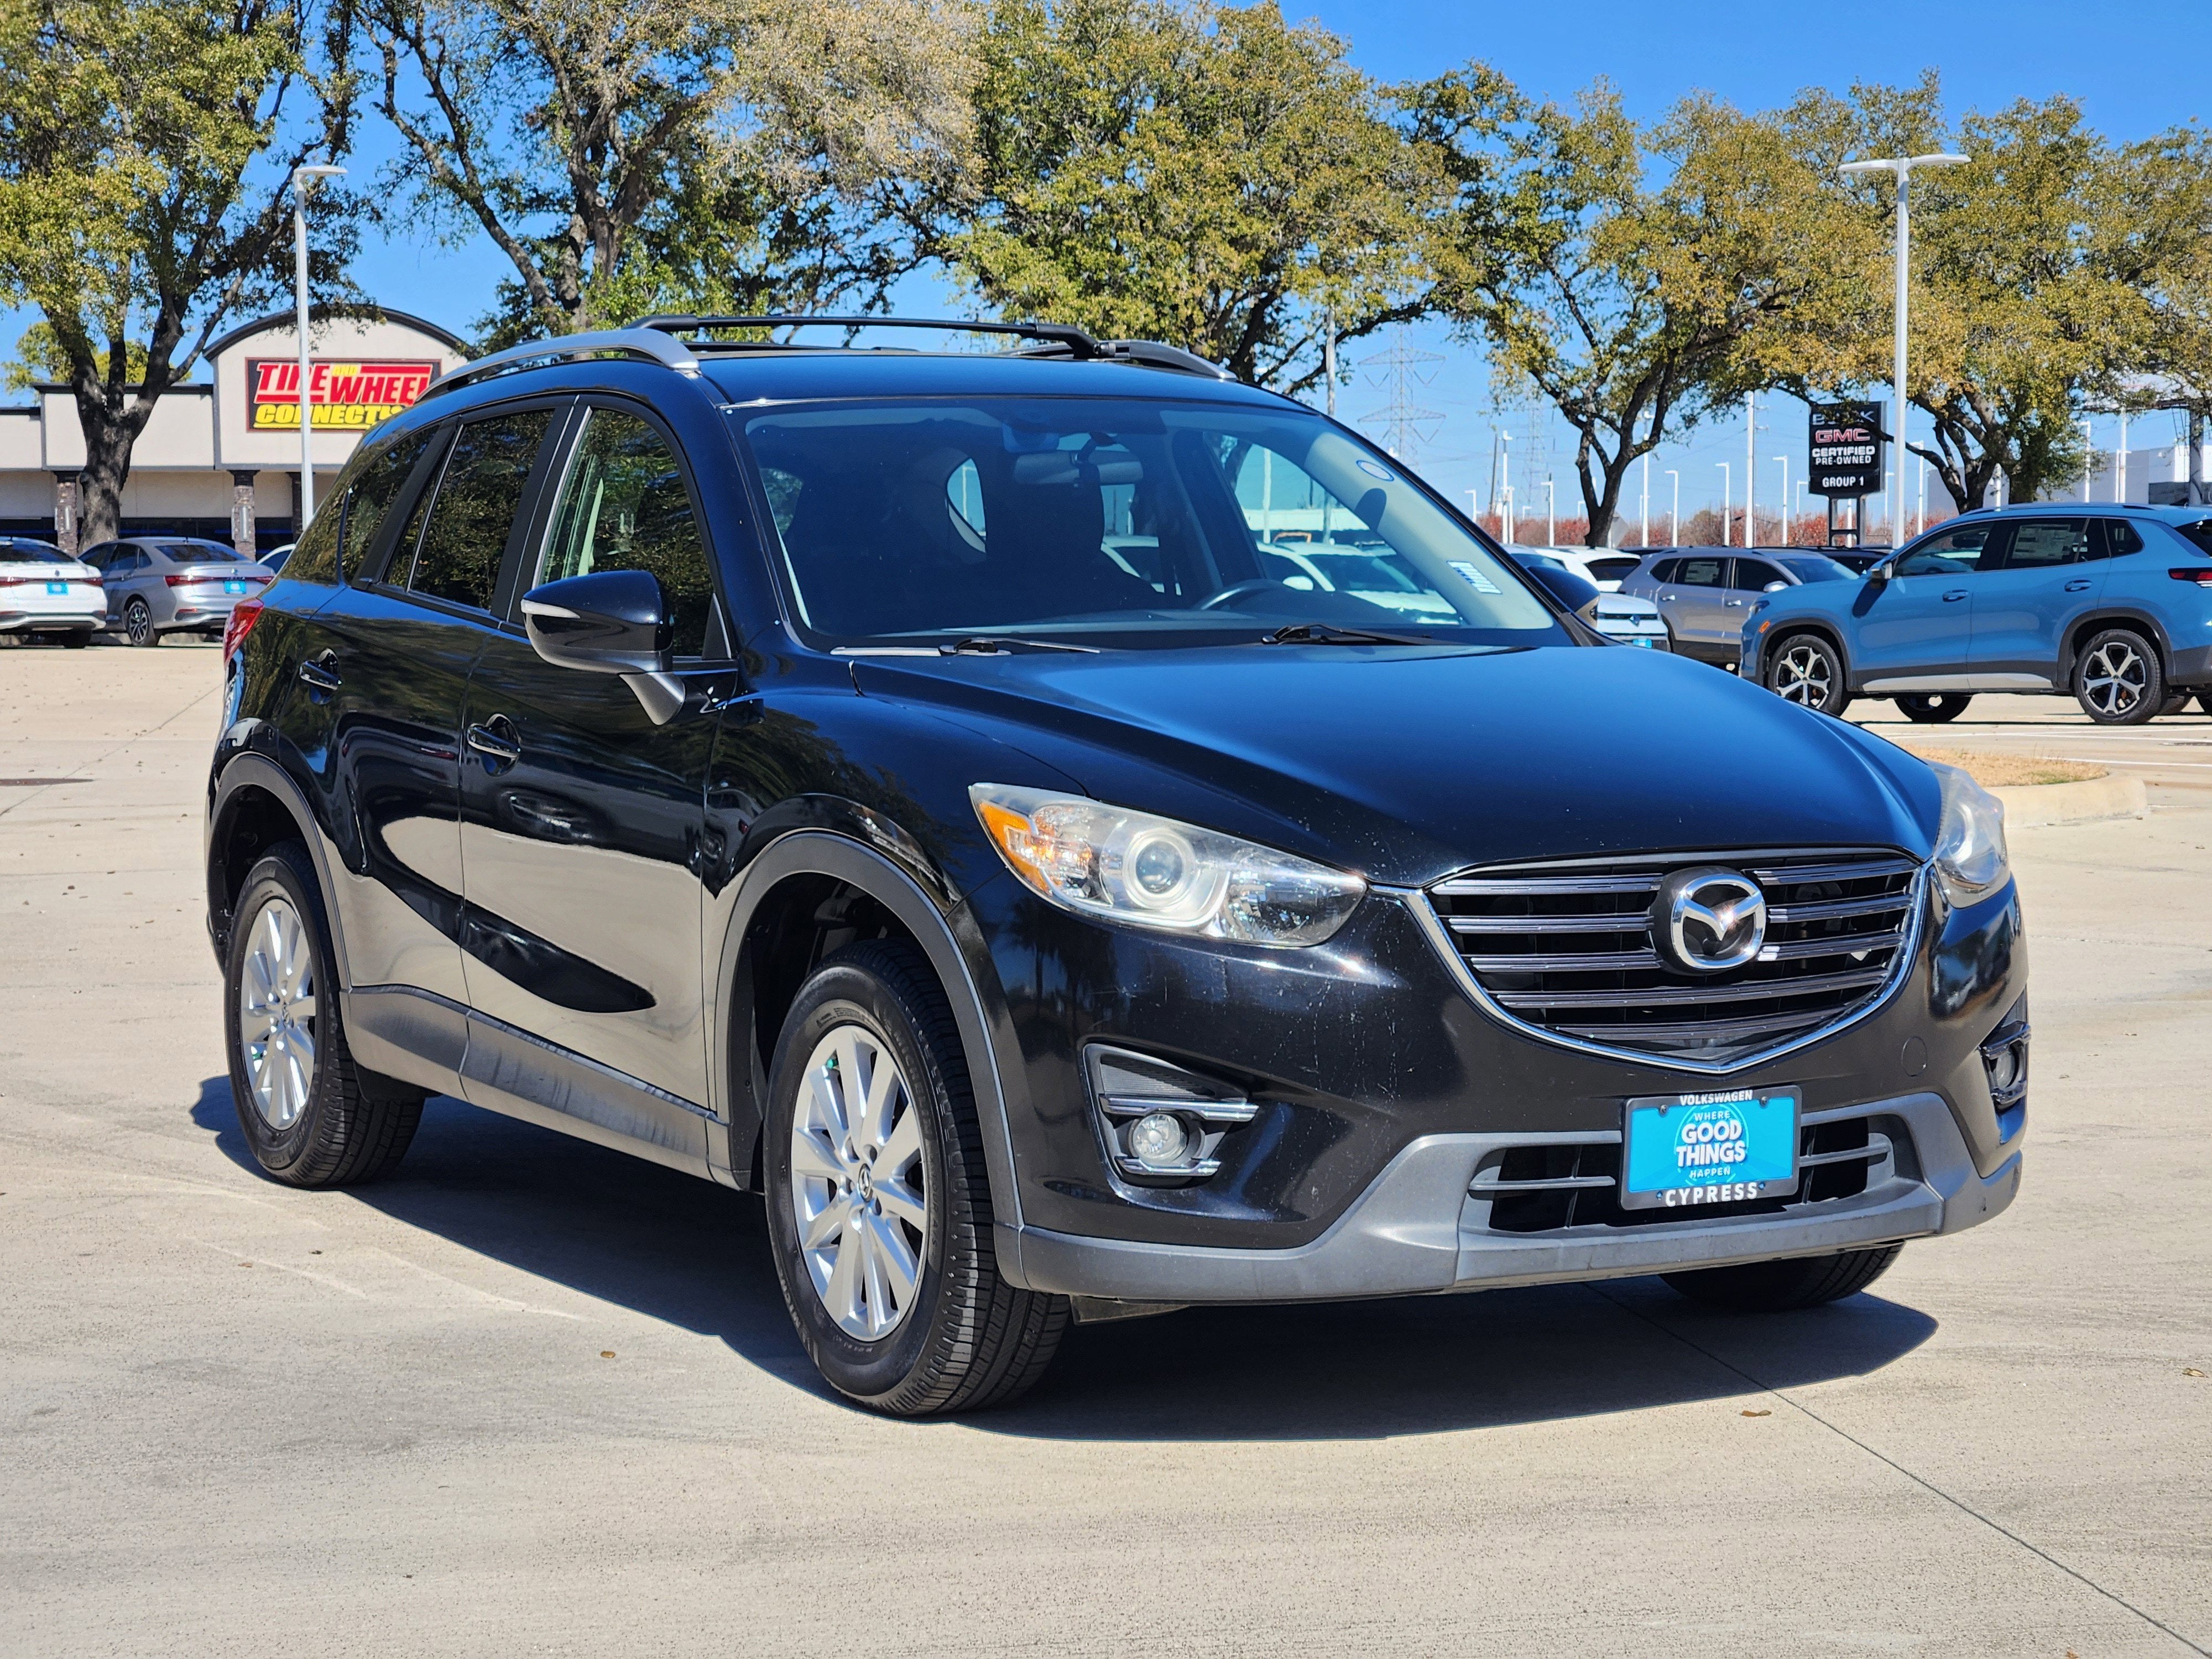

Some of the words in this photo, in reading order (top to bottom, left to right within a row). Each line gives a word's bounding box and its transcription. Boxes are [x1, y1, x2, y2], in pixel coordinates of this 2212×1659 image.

[332, 365, 358, 376] AND
[1815, 427, 1870, 443] GMC
[1812, 445, 1875, 457] CERTIFIED
[1815, 456, 1871, 465] PRE-OWNED
[1822, 476, 1856, 487] GROUP
[1859, 476, 1864, 486] 1
[1680, 1089, 1753, 1105] VOLKSWAGEN
[1694, 1110, 1731, 1121] WHERE
[1681, 1119, 1743, 1144] GOOD
[1676, 1141, 1746, 1167] THINGS
[1689, 1166, 1731, 1178] HAPPEN
[1665, 1182, 1757, 1207] CYPRESS
